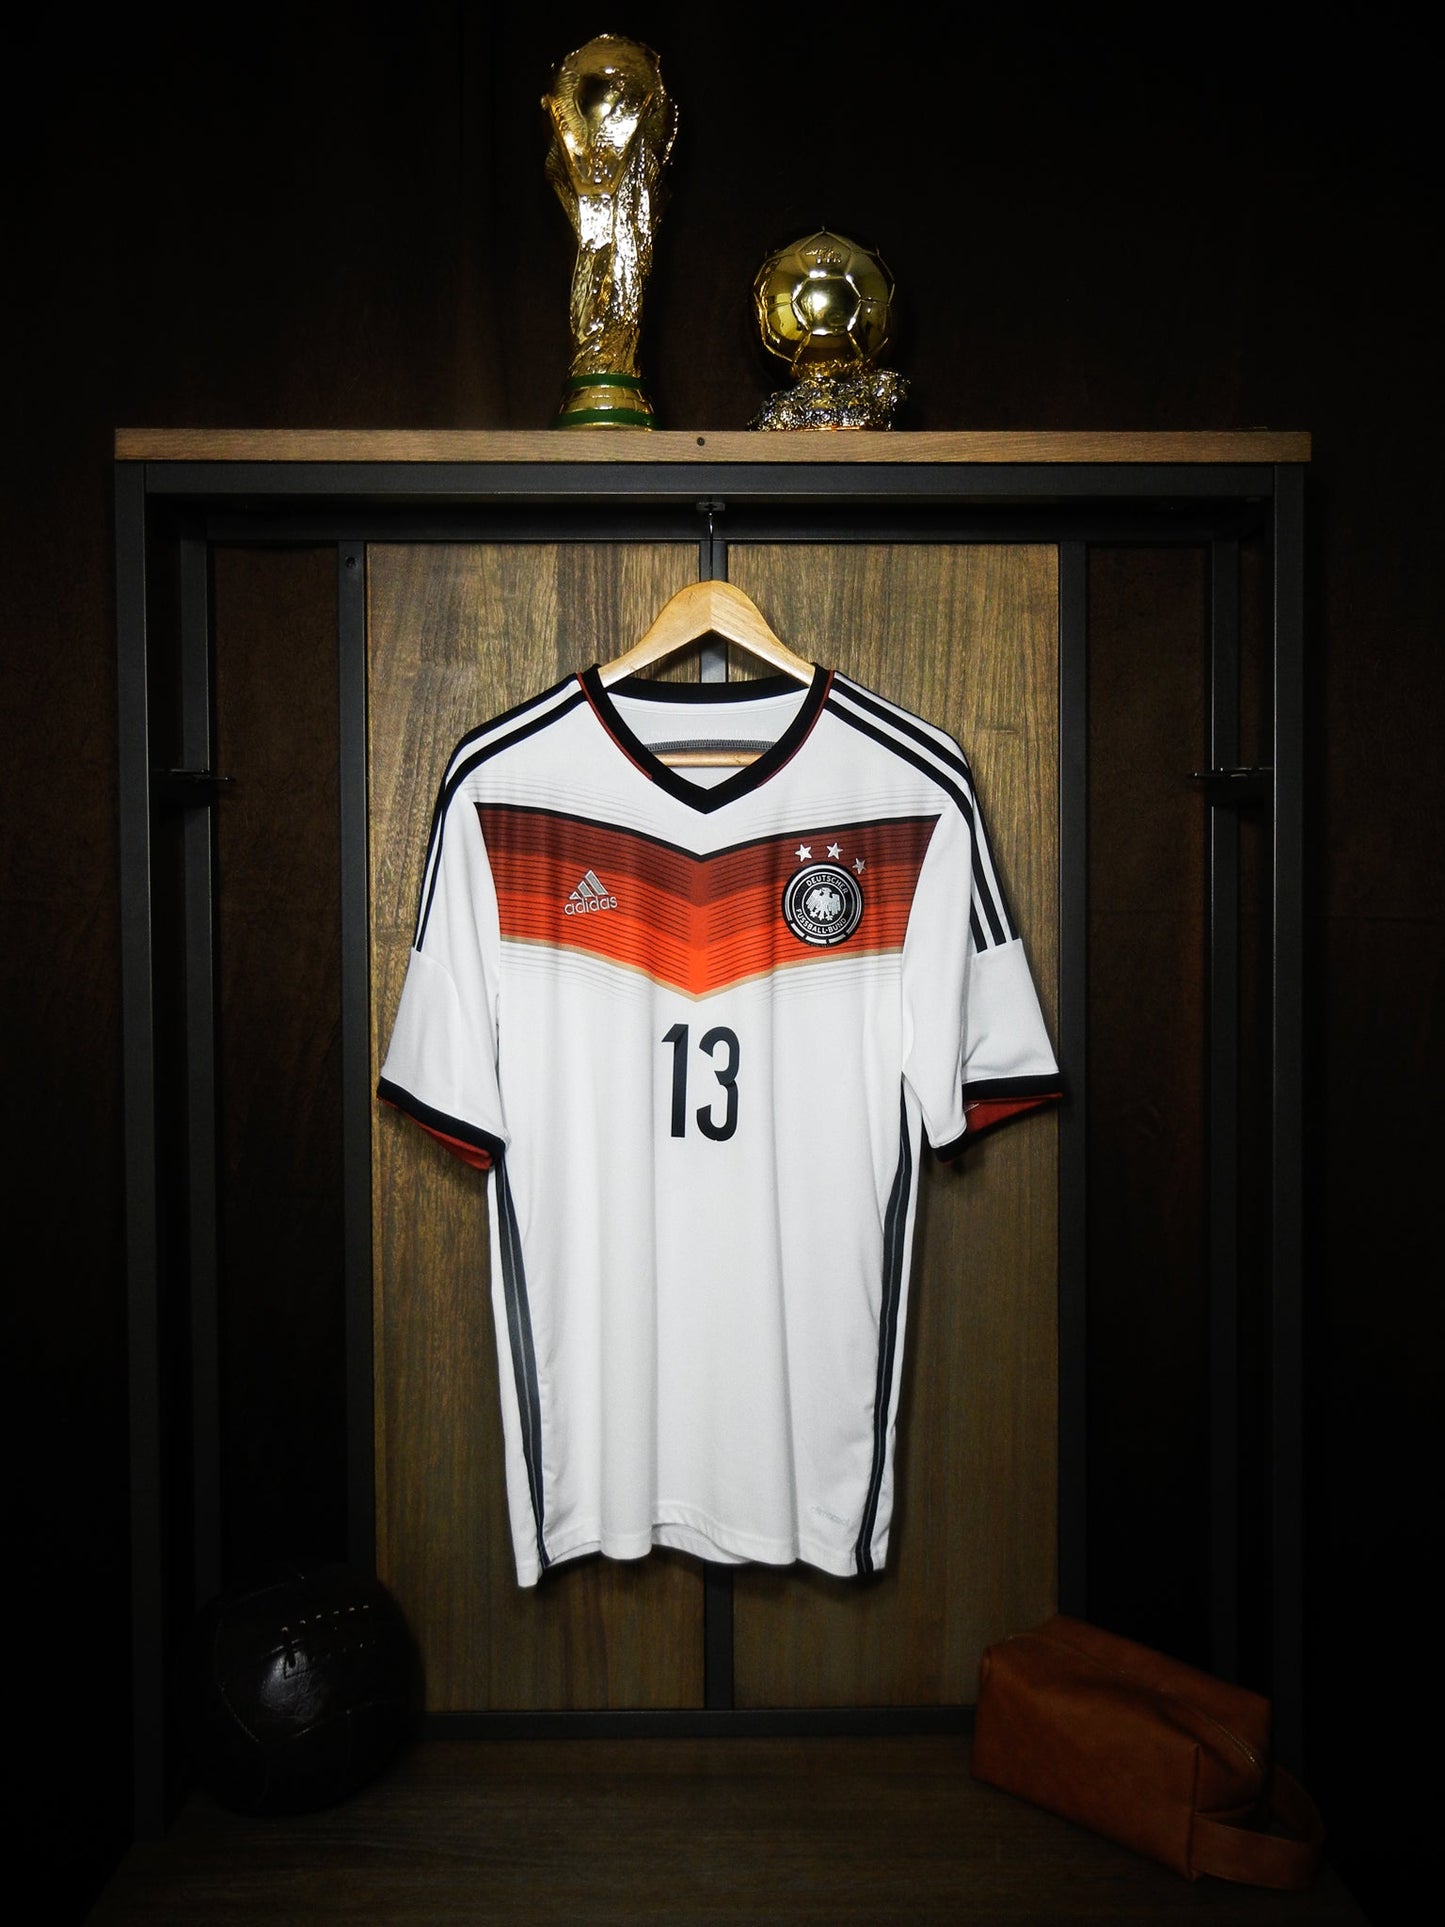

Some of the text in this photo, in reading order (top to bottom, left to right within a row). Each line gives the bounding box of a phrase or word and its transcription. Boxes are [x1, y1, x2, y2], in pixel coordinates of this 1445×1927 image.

[806, 875, 849, 894] DEUTSCHER
[564, 896, 618, 915] adidas
[661, 1023, 740, 1142] 13
